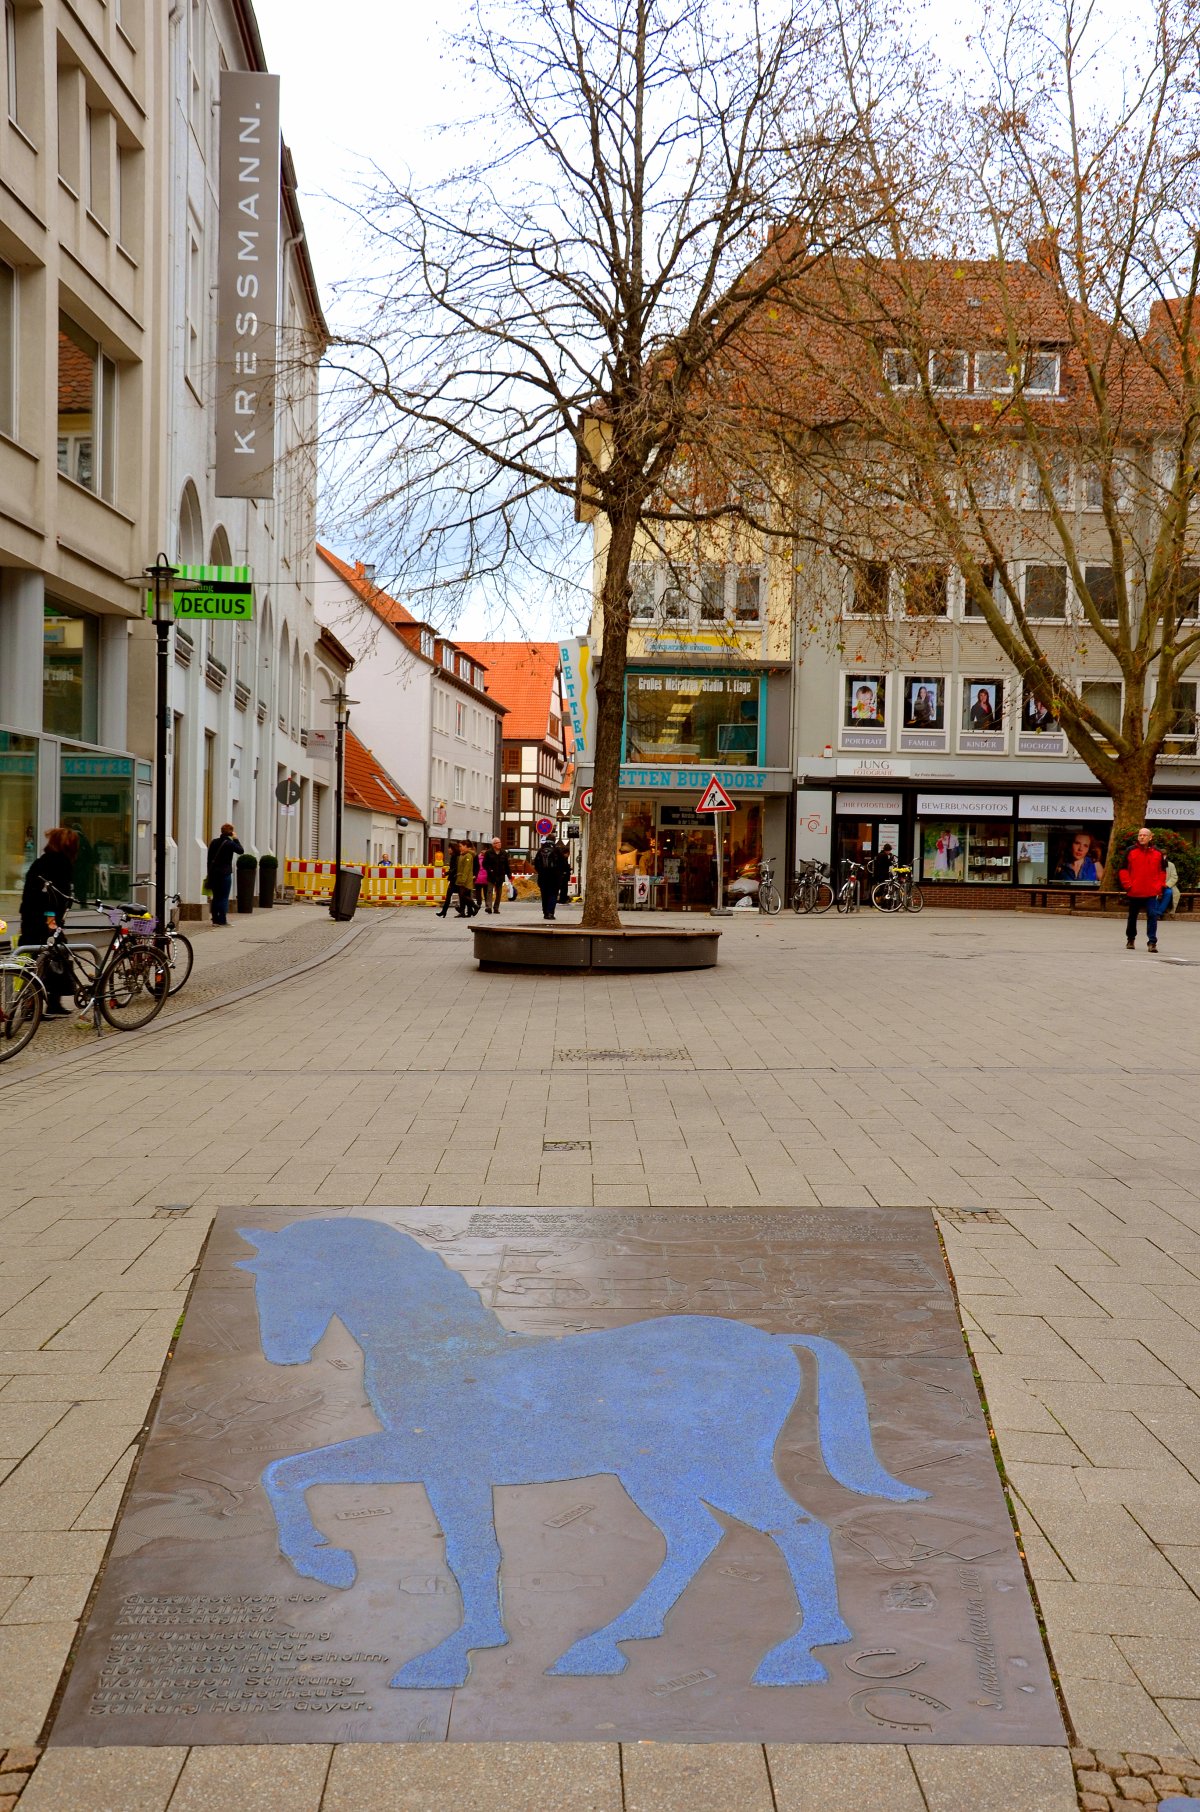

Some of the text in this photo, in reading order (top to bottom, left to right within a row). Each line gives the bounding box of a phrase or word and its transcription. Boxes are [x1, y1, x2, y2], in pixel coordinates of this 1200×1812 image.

[234, 101, 263, 455] KRESSMANN.
[181, 597, 246, 615] DECIUS
[638, 677, 663, 691] Großes
[702, 679, 724, 693] Studio
[734, 681, 751, 695] Etage
[561, 648, 585, 752] BETTEN
[845, 738, 883, 746] PORTRAIT
[908, 739, 938, 747] FAMILIE
[967, 741, 997, 749] KINDER
[1020, 742, 1061, 750] HOCHZEIT
[858, 760, 890, 770] JUNG
[619, 770, 672, 787] ETTEN
[921, 802, 1008, 811] BEWERBUNGSFOTOS
[1030, 804, 1108, 814] ALBEN & RAHMEN
[1148, 806, 1195, 816] PASSFOTOS
[244, 1673, 356, 1688] Stiftung
[92, 1687, 139, 1701] und
[144, 1686, 191, 1701] der
[89, 1702, 201, 1716] Stiftung
[209, 1701, 283, 1713] Heinz
